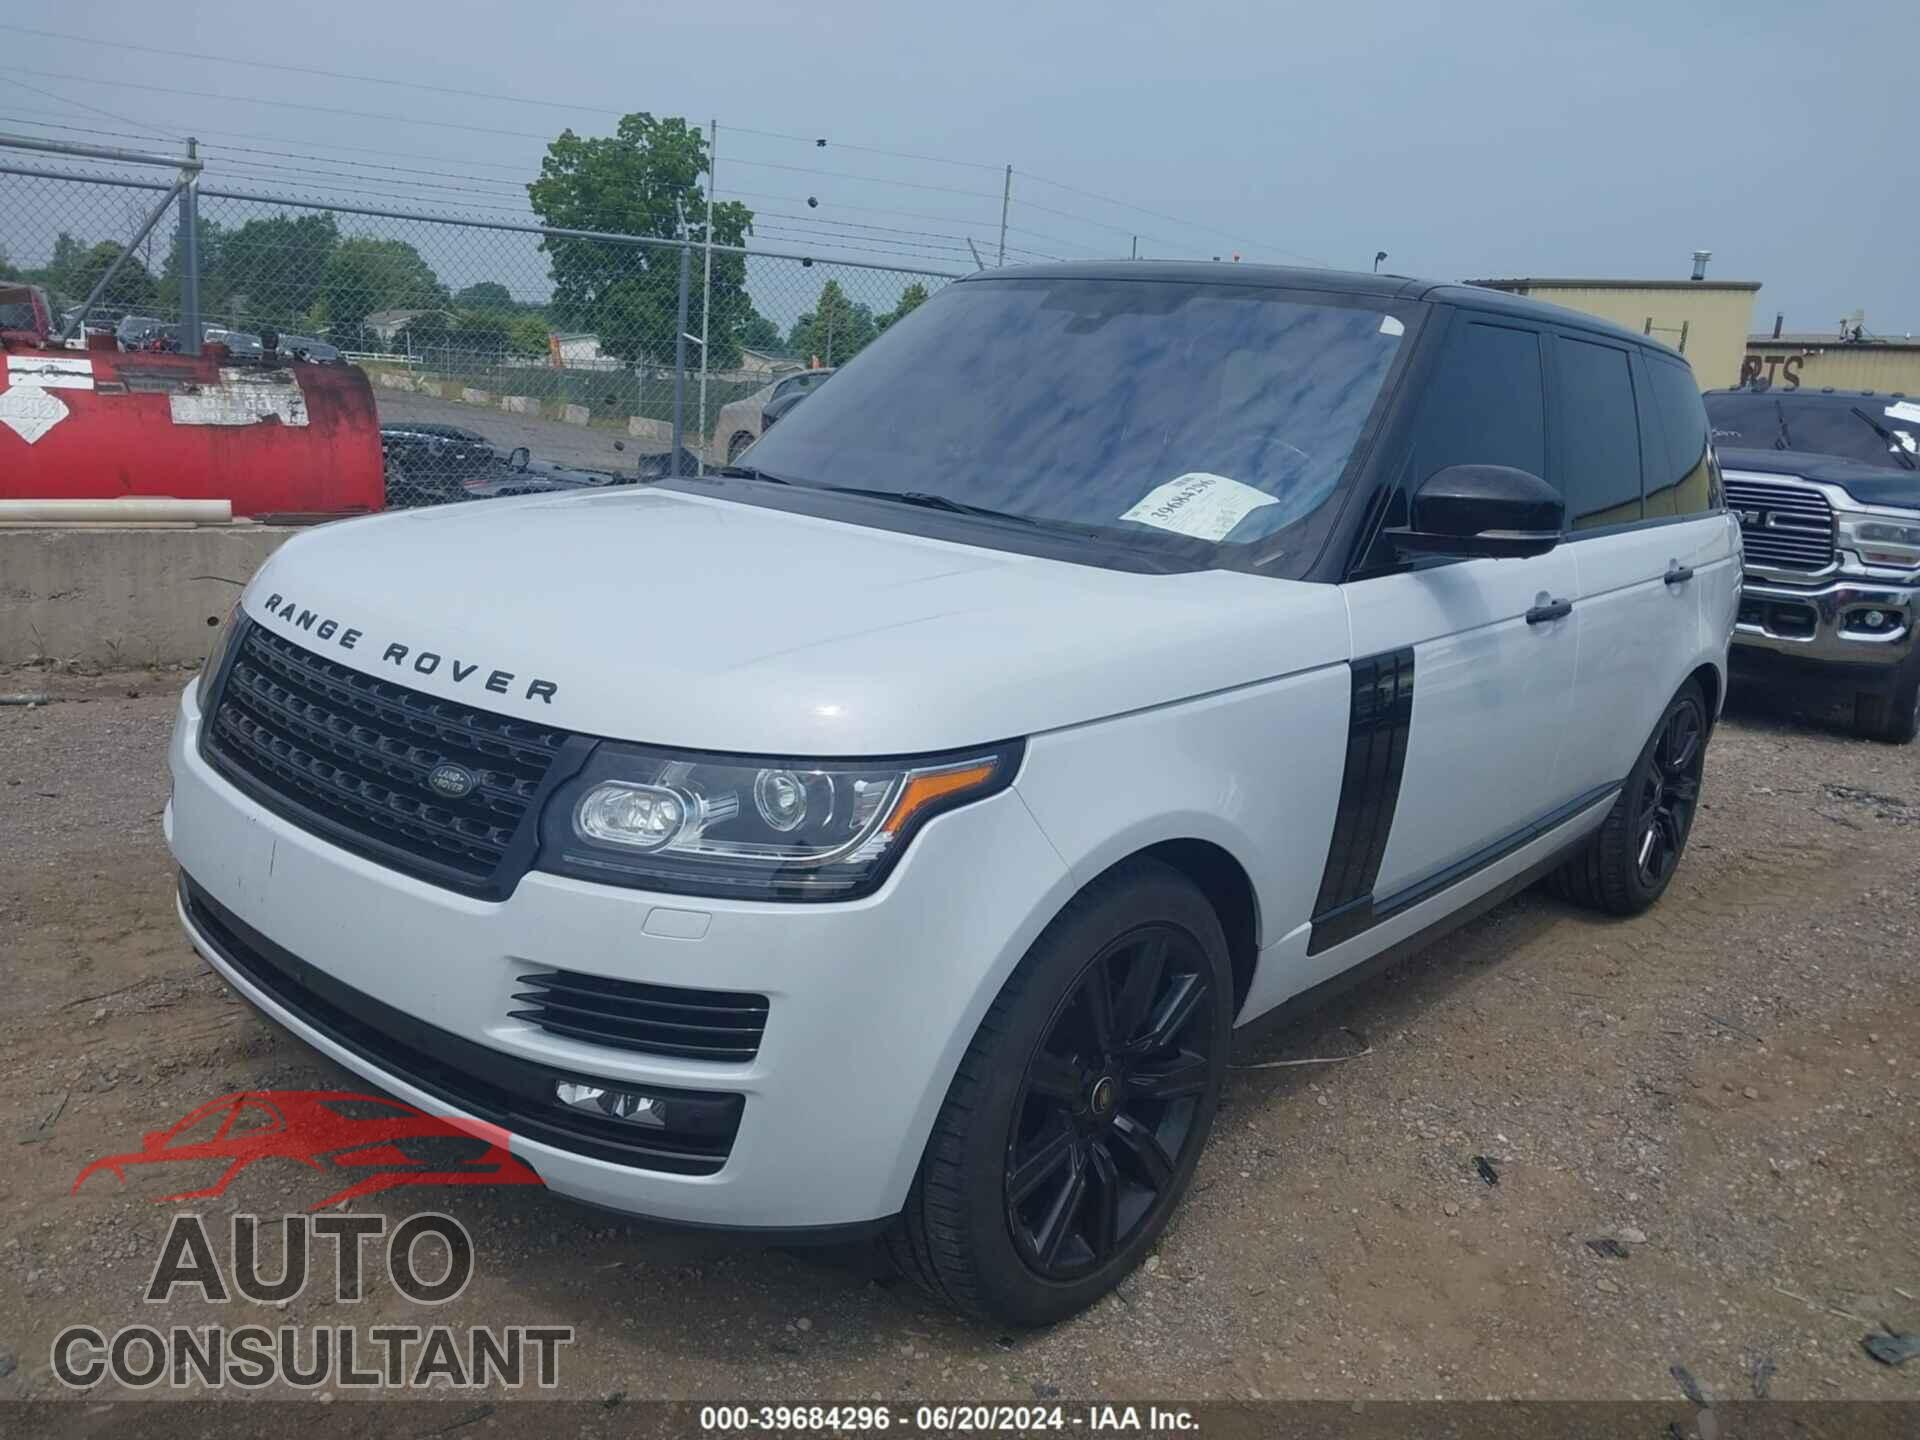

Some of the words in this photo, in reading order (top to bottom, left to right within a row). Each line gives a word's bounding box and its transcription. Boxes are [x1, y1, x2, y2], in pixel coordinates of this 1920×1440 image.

[1151, 479, 1217, 521] 39684296
[264, 593, 362, 649] RANGE
[382, 643, 558, 704] ROVER
